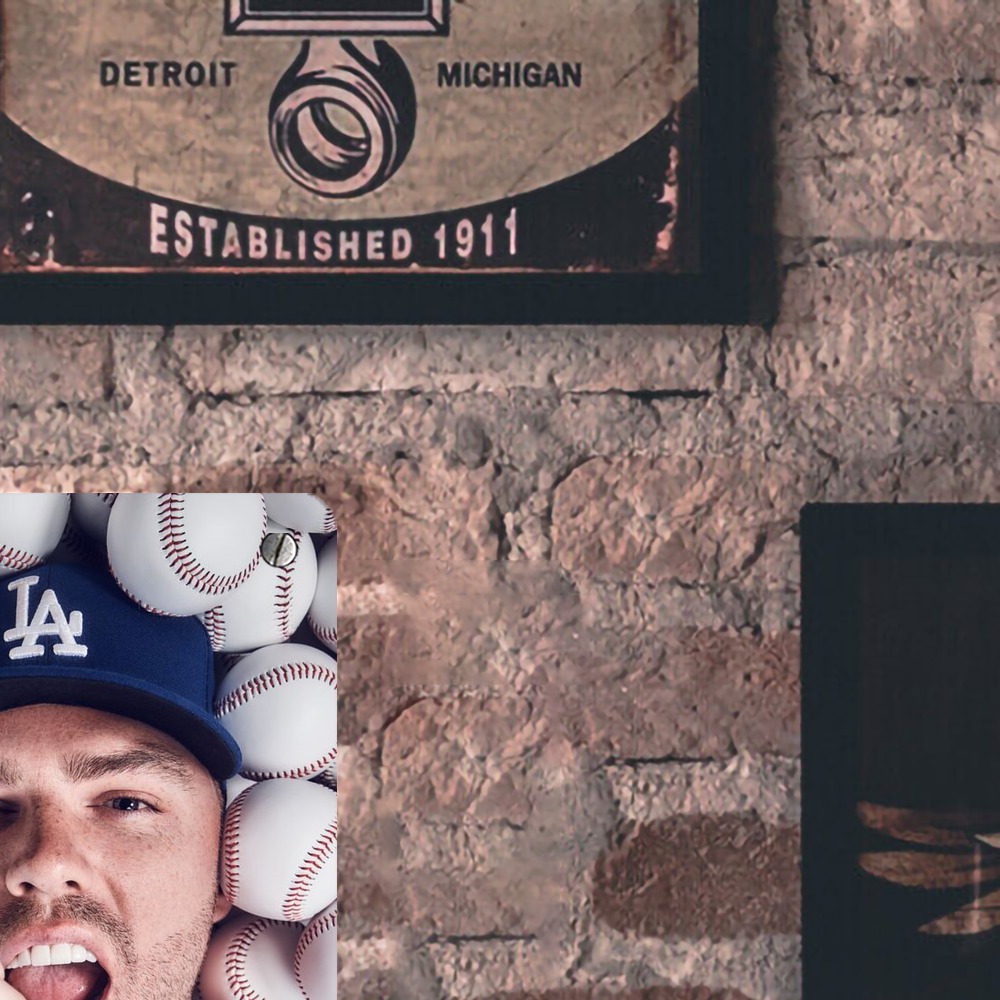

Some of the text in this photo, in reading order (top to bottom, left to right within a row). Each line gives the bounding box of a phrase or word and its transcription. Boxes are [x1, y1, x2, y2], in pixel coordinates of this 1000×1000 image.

[100, 60, 582, 88] DETROIT MICHIGAN
[149, 202, 517, 260] ESTABLISHED 1911
[3, 575, 88, 660] LA
